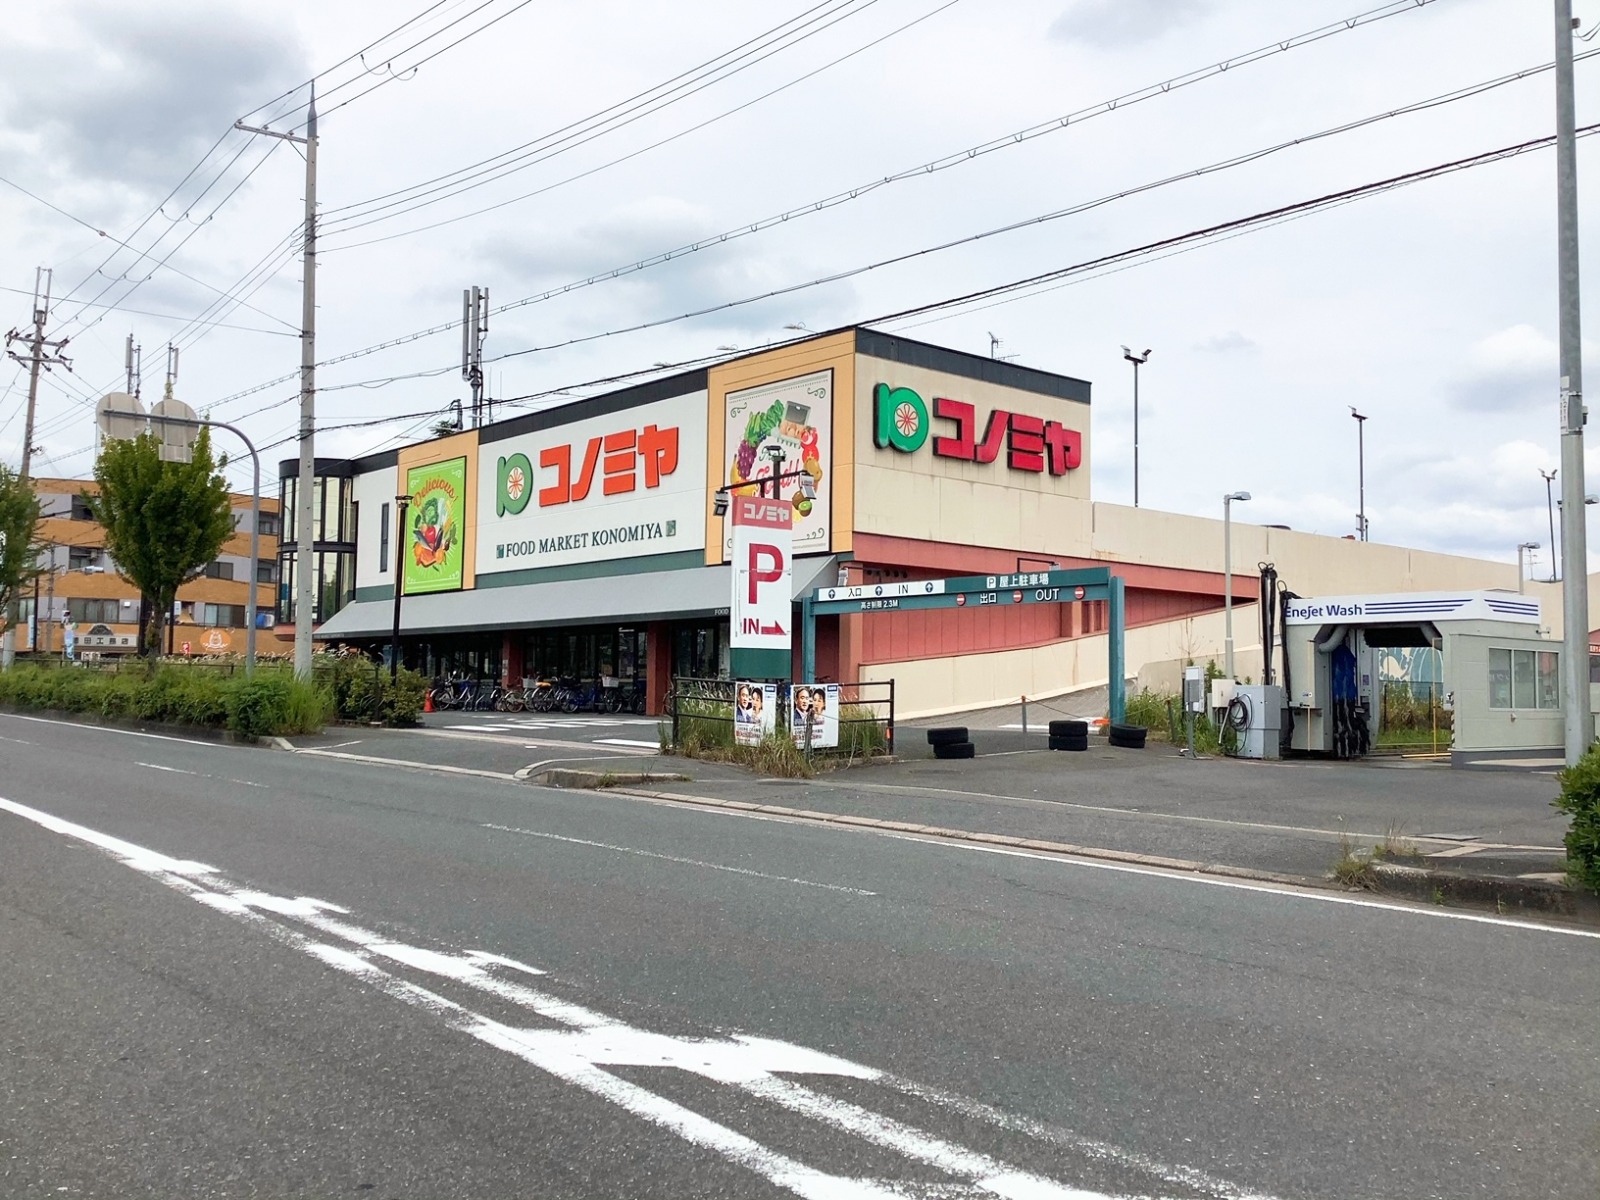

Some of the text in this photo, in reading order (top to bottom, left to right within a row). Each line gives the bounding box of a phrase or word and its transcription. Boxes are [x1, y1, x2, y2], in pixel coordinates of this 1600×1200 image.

[933, 398, 1081, 475] コノミヤ
[539, 424, 679, 507] コノミヤ
[743, 503, 790, 523] コノミヤ
[506, 522, 663, 558] FOOD MARKET KONOMIYA
[748, 543, 784, 604] P
[999, 573, 1049, 588] 屋上駐車場
[848, 584, 909, 598] 入口 IN
[979, 588, 1060, 604] 出口 OUT
[714, 608, 730, 616] FOOD
[883, 599, 899, 609] 2.3M
[1286, 604, 1362, 619] Enejet Wash
[743, 617, 759, 635] IN
